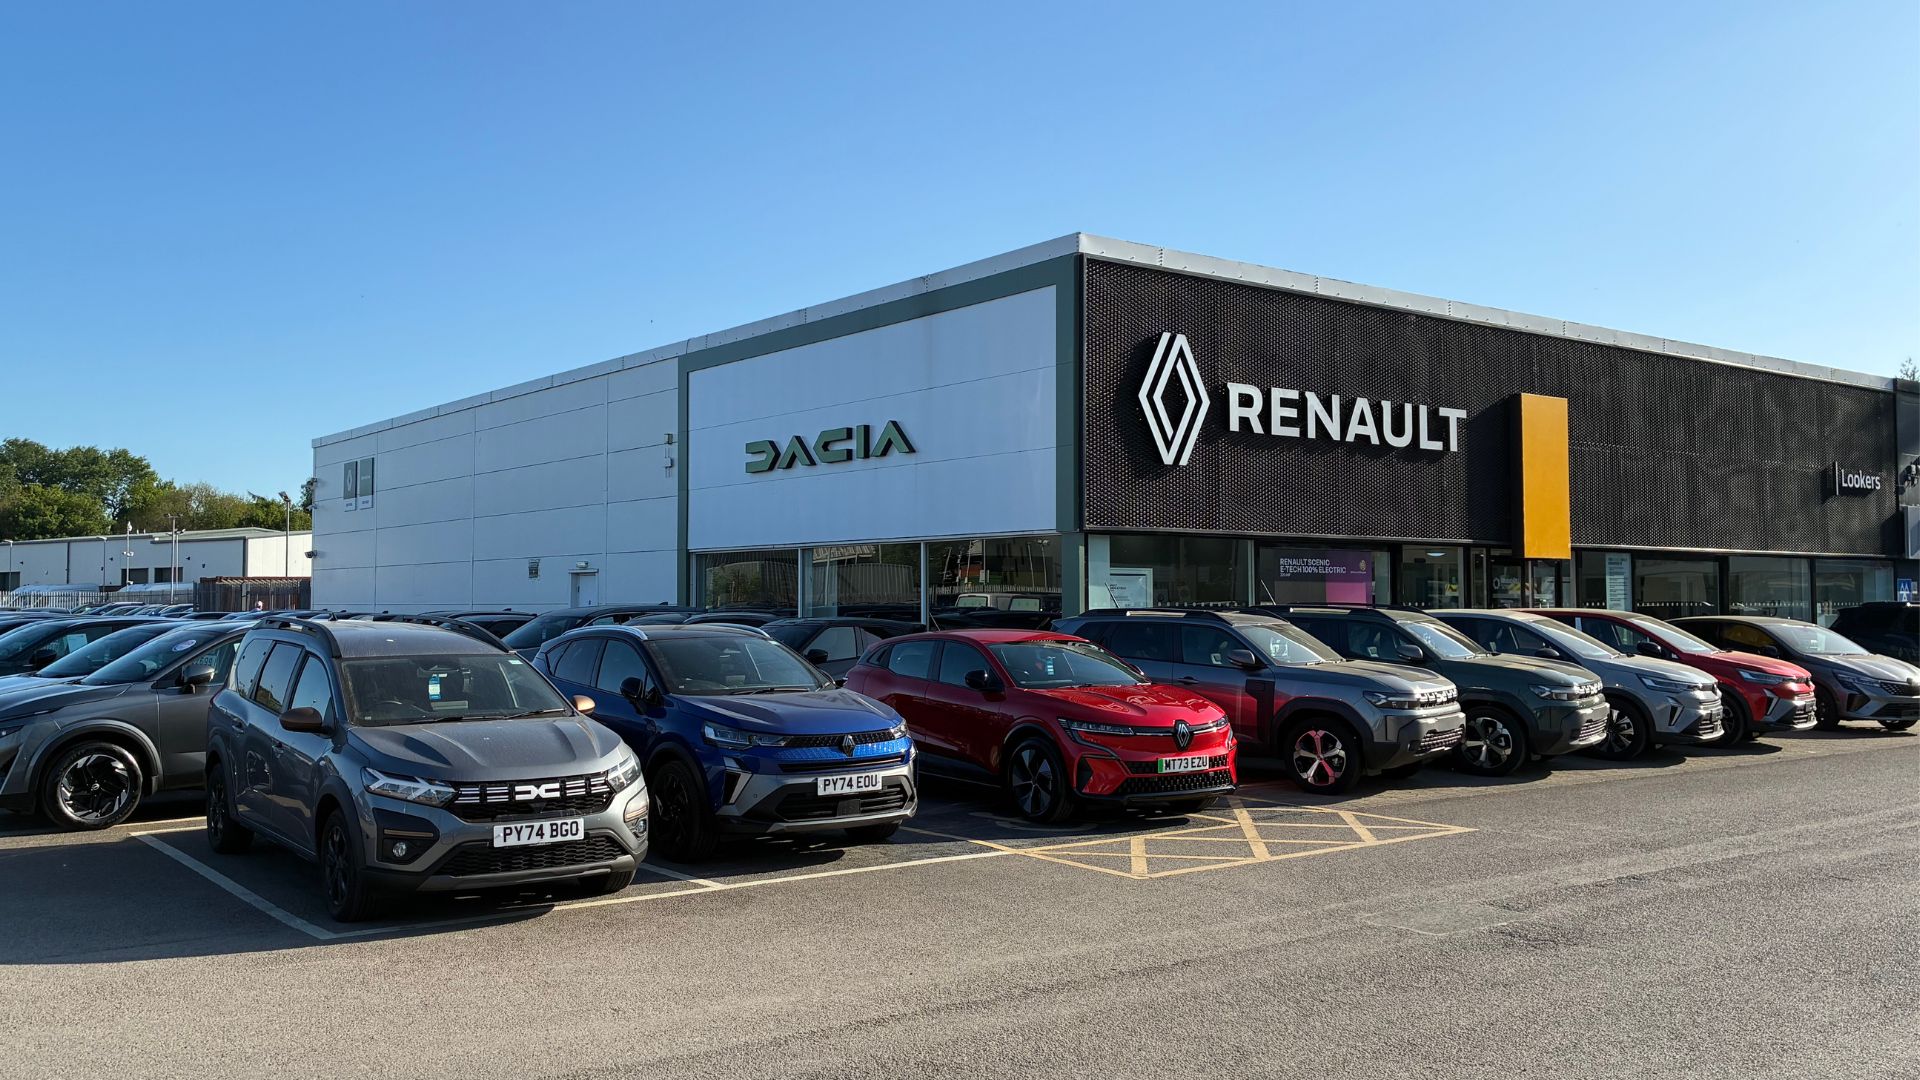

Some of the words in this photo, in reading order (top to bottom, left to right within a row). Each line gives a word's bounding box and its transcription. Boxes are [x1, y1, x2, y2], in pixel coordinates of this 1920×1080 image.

[1227, 382, 1468, 452] RENAULT
[745, 420, 916, 474] DACIA
[1841, 468, 1881, 490] Lookers
[1191, 756, 1207, 768] EZU
[823, 777, 853, 791] PY74
[856, 774, 878, 789] EOU
[503, 824, 545, 842] PY74
[549, 820, 579, 838] BGO
